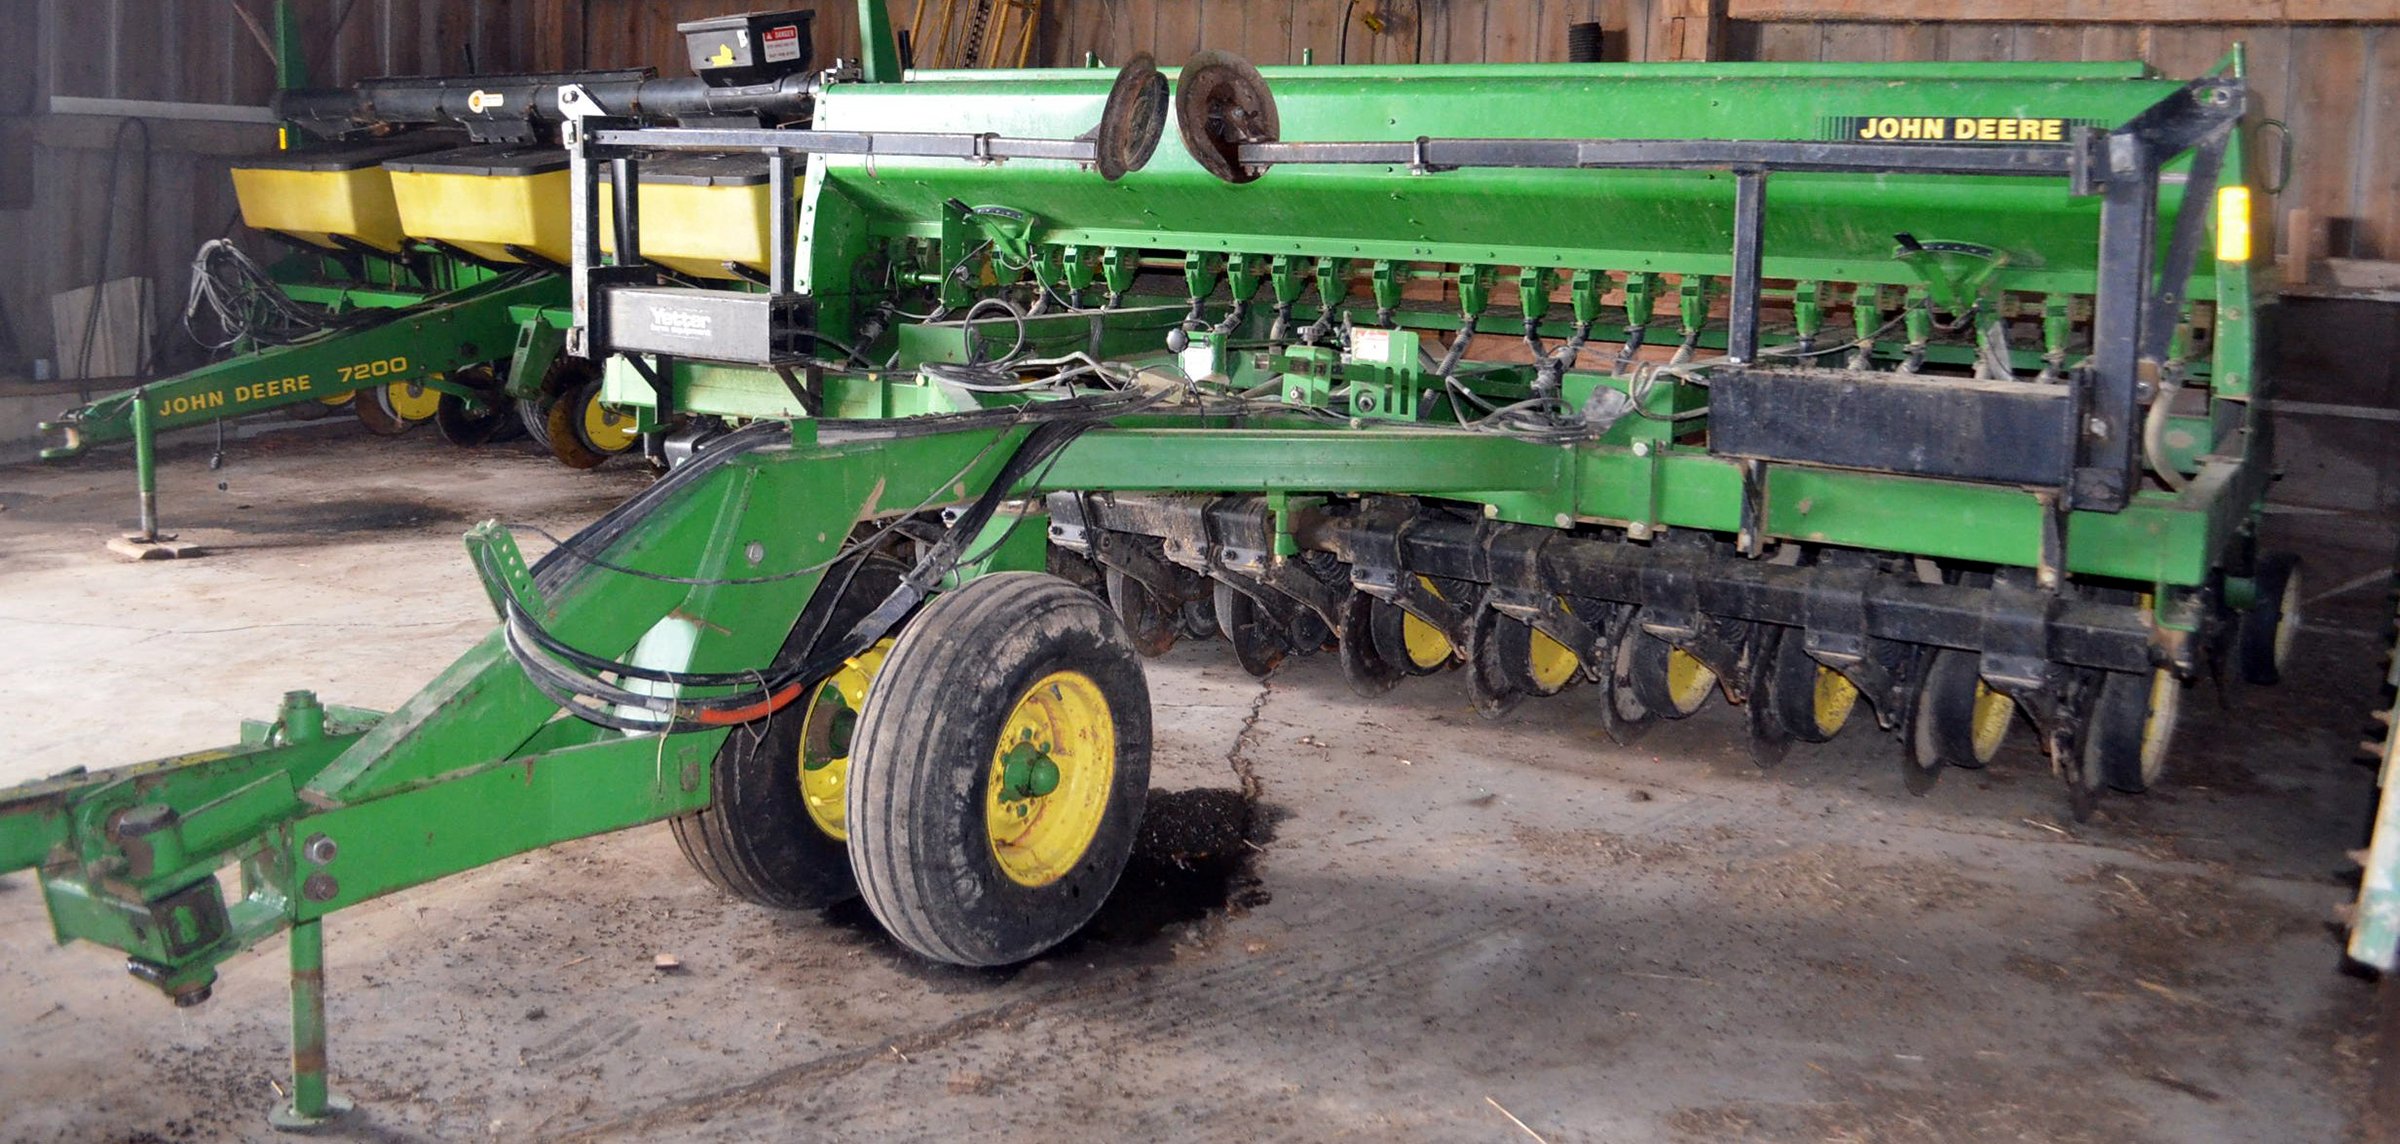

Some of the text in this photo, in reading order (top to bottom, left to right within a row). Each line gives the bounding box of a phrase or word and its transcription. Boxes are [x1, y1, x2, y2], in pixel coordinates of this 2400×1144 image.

[1860, 118, 2063, 140] JOHN DEERE
[649, 306, 711, 329] Yetter
[160, 356, 408, 416] JOHN DEERE 7200
